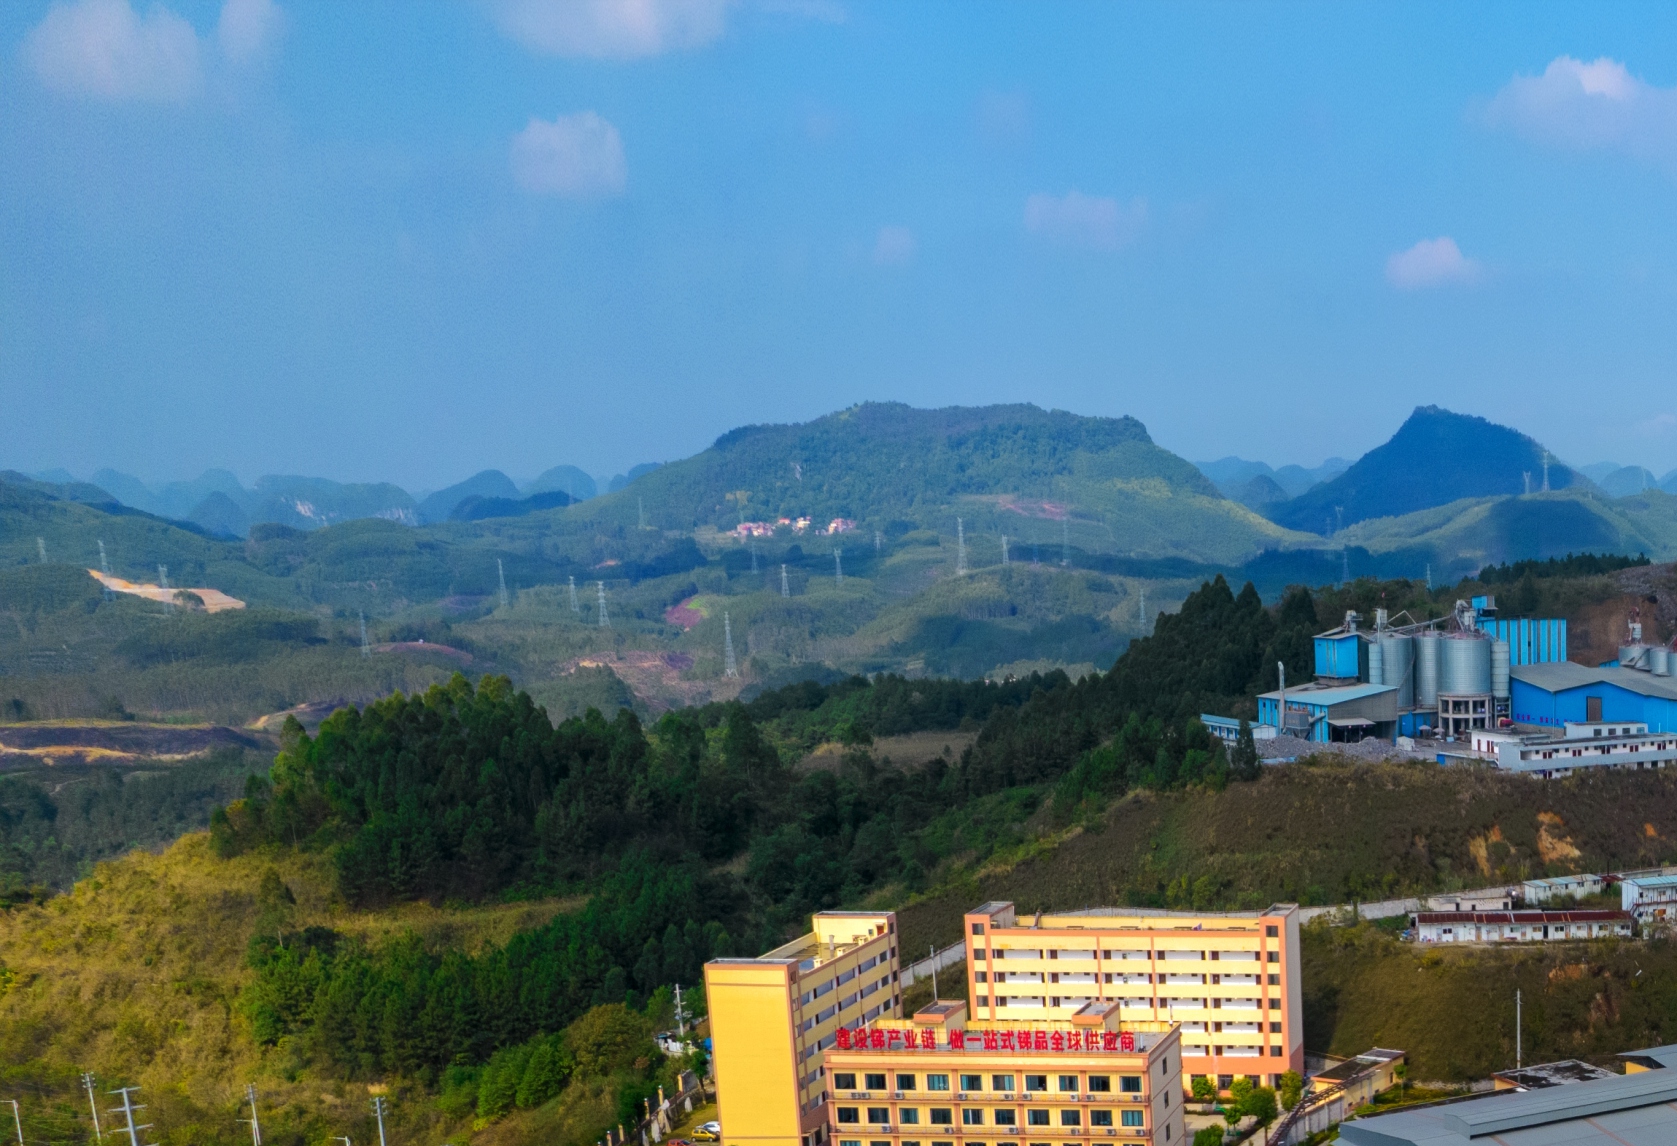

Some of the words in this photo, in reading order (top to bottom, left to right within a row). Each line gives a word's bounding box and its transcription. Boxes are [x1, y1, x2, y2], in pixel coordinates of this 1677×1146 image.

[836, 1028, 936, 1049] 建设锑产业链
[950, 1029, 1135, 1052] 做一站式锑品全球供应商
